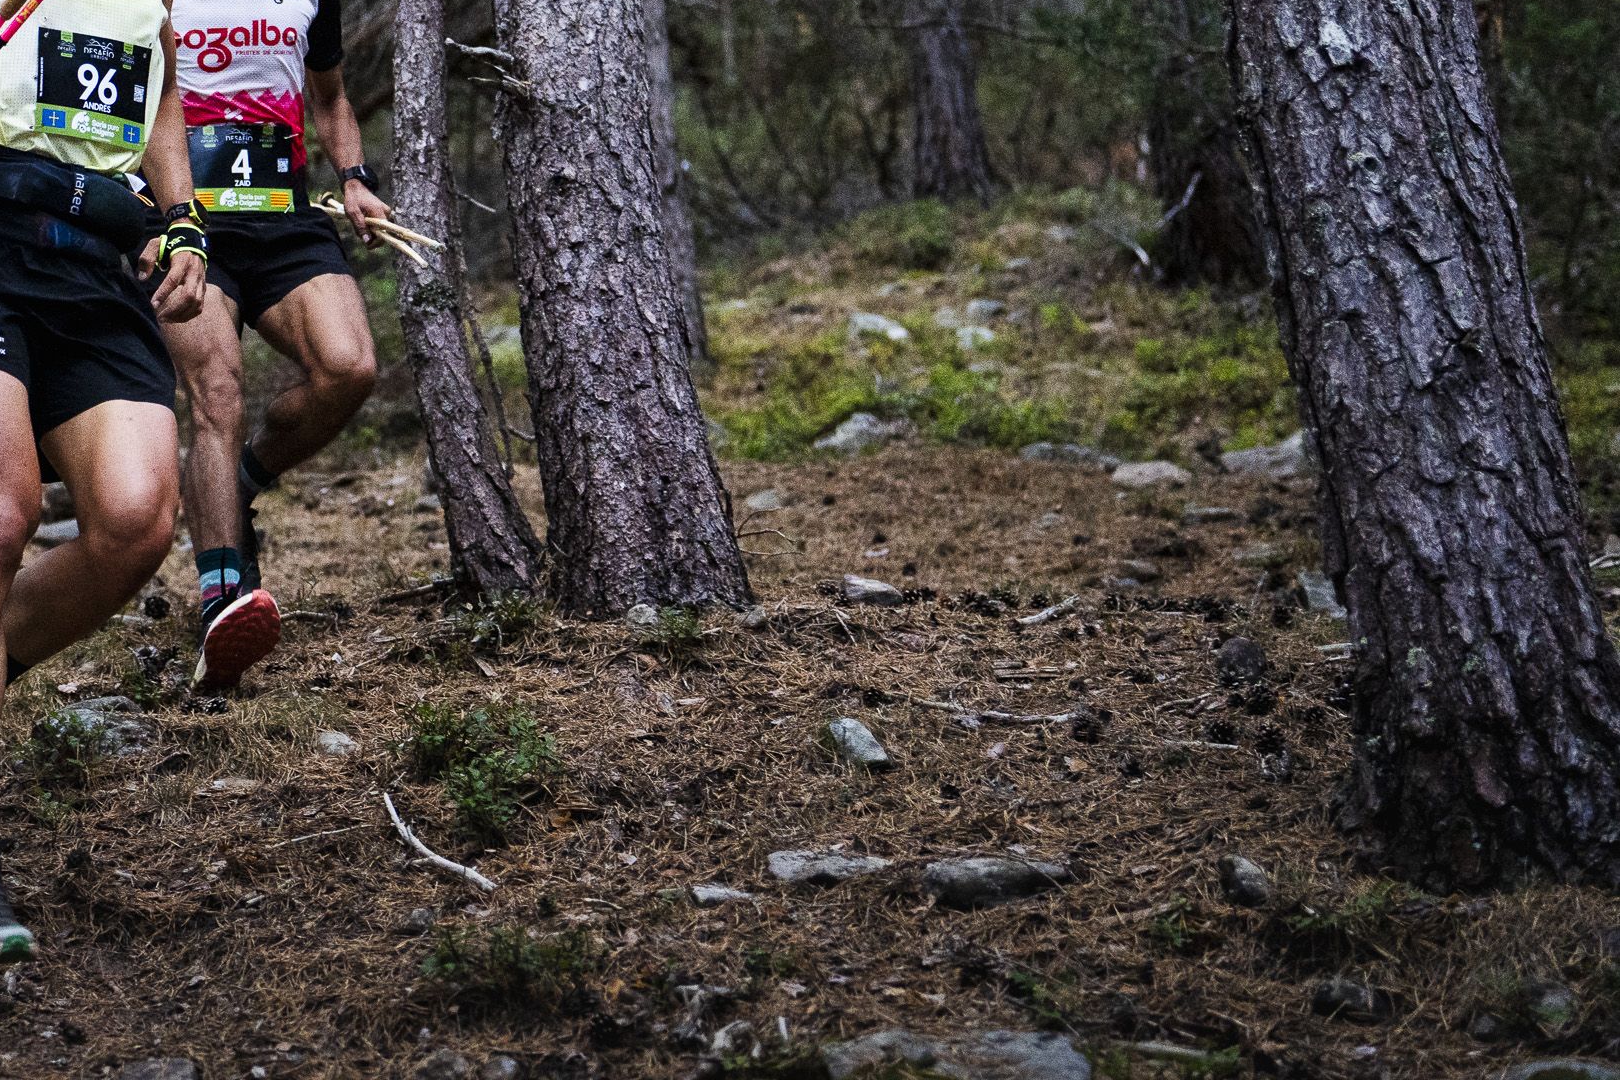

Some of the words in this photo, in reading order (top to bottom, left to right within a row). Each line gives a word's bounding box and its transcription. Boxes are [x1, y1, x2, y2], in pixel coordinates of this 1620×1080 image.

[77, 63, 118, 106] 96
[231, 149, 253, 180] 4
[234, 179, 251, 187] ZAID
[70, 172, 86, 216] naked
